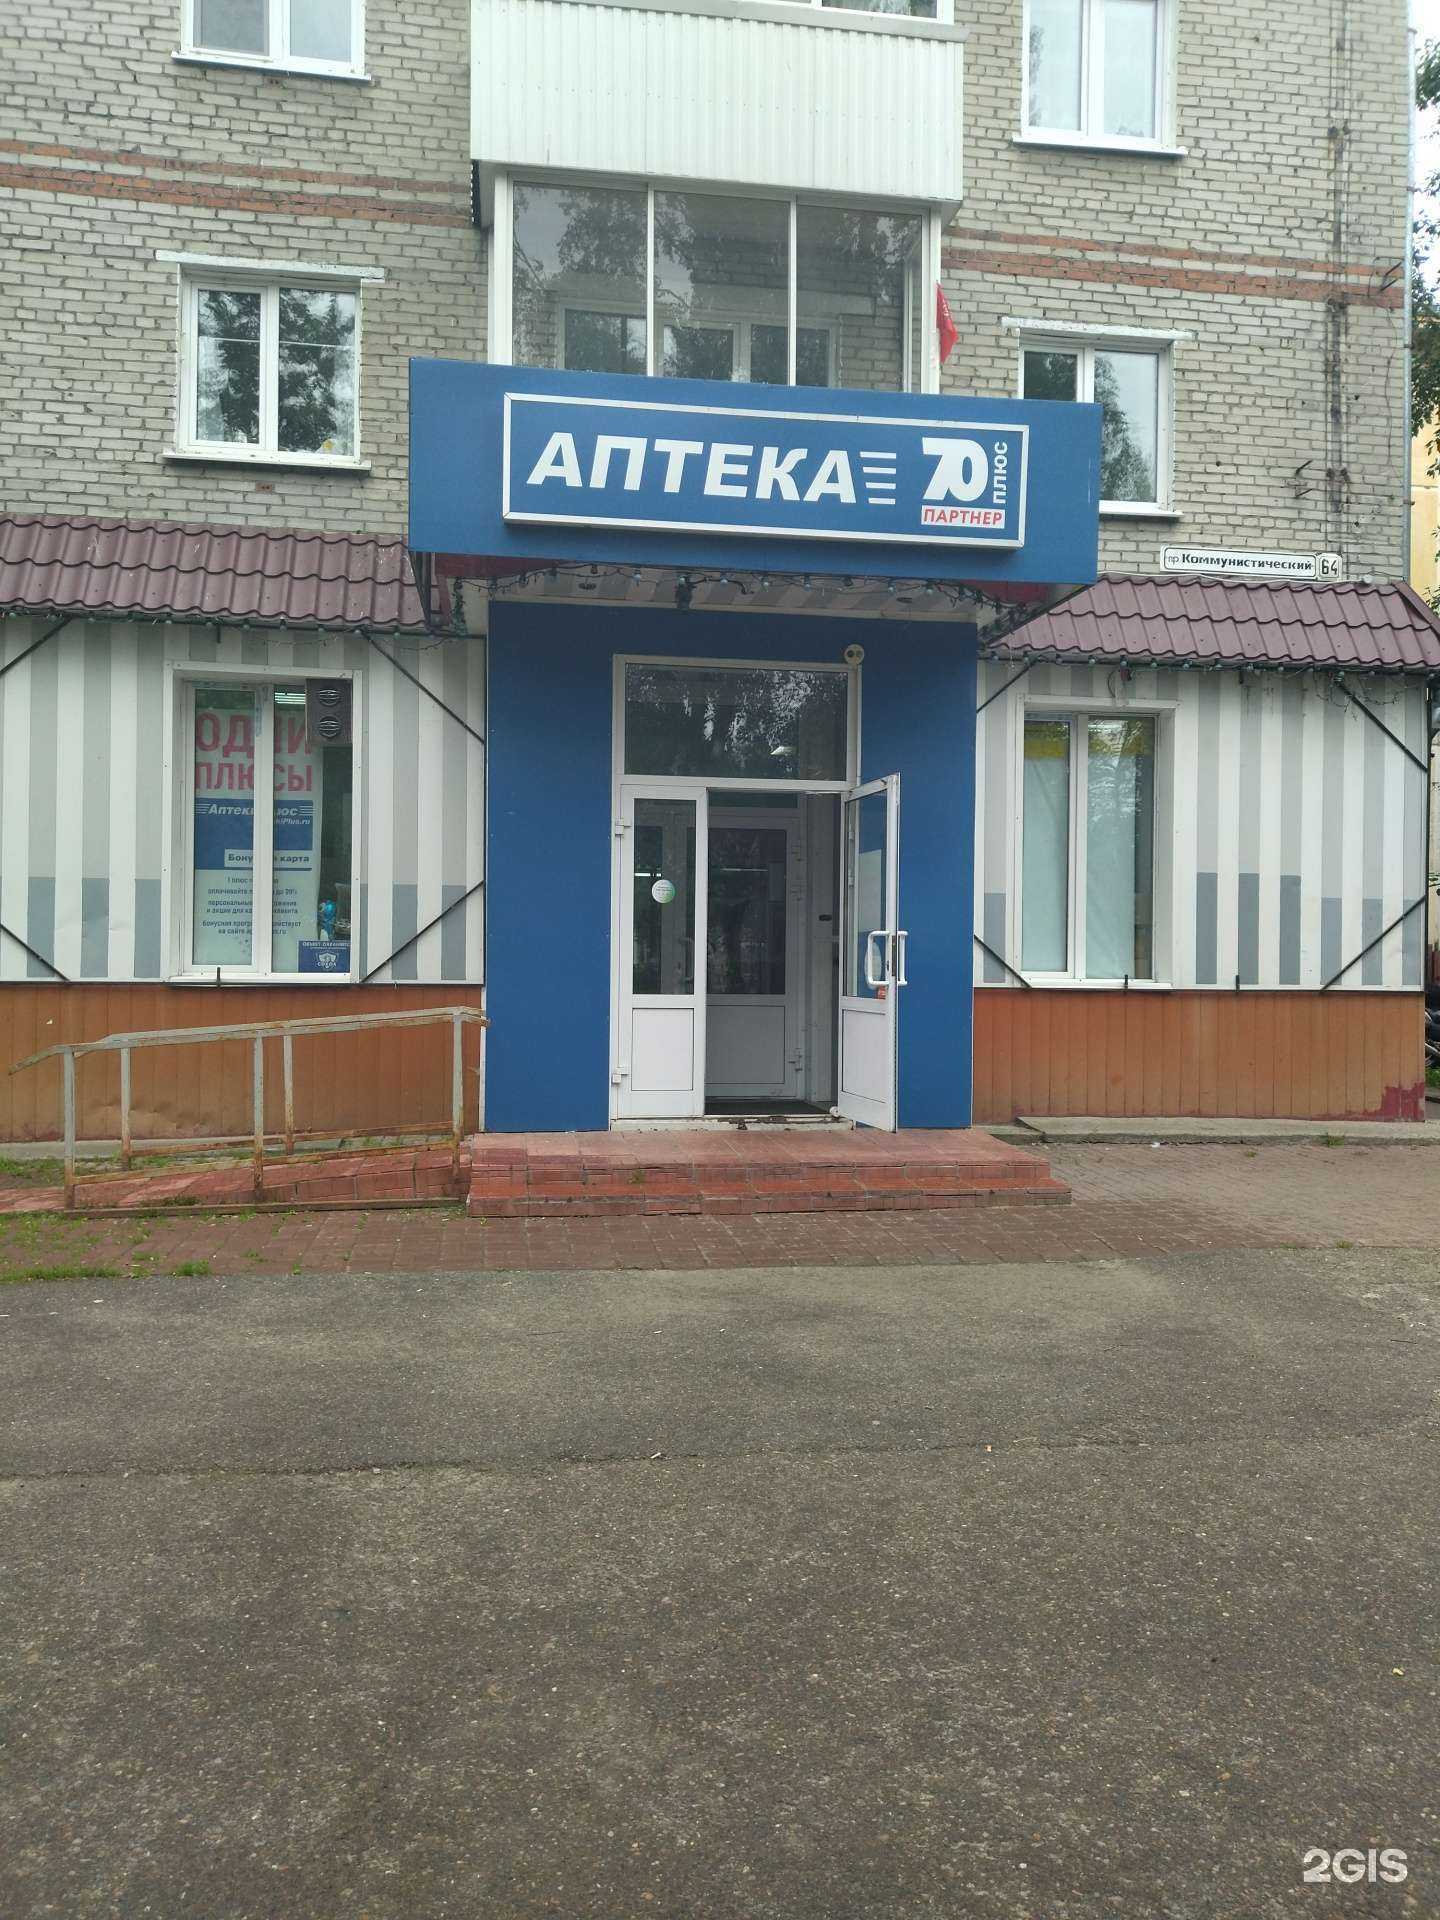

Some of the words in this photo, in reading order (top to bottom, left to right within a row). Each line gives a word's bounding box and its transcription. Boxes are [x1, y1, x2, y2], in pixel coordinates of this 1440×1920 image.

[526, 432, 857, 504] АПТЕКА
[922, 437, 989, 501] 70
[993, 441, 1008, 504] ПЛЮС
[923, 509, 1003, 525] ПАРТНЕР
[1181, 553, 1313, 571] Коммунистический
[1321, 558, 1338, 575] 64
[280, 855, 310, 863] карта
